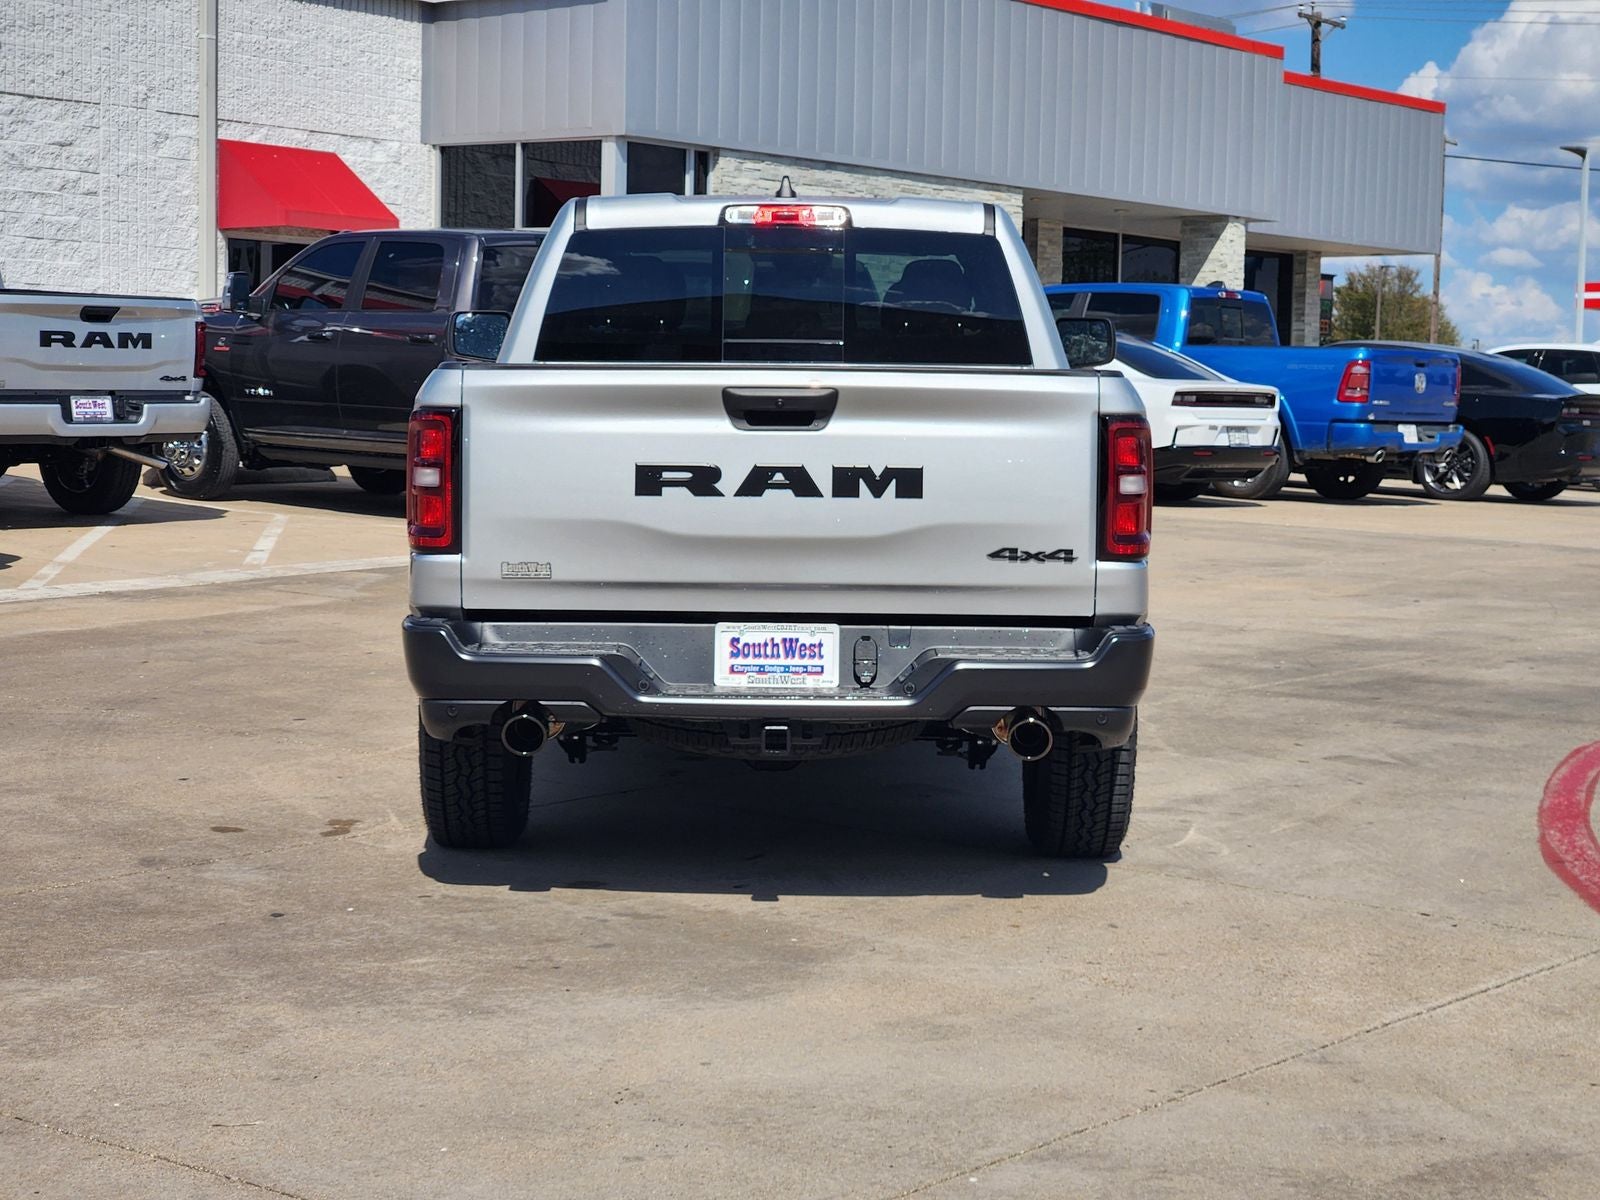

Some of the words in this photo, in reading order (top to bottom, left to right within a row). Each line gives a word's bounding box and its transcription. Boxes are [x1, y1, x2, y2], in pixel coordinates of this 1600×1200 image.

[39, 330, 152, 349] RAM
[634, 462, 924, 499] RAM
[986, 547, 1078, 563] 4x4
[729, 636, 824, 660] SouthWest
[733, 665, 760, 673] Chrysler
[764, 665, 785, 673] Dodge
[788, 665, 804, 674] Jeep
[747, 675, 807, 685] SouthWest
